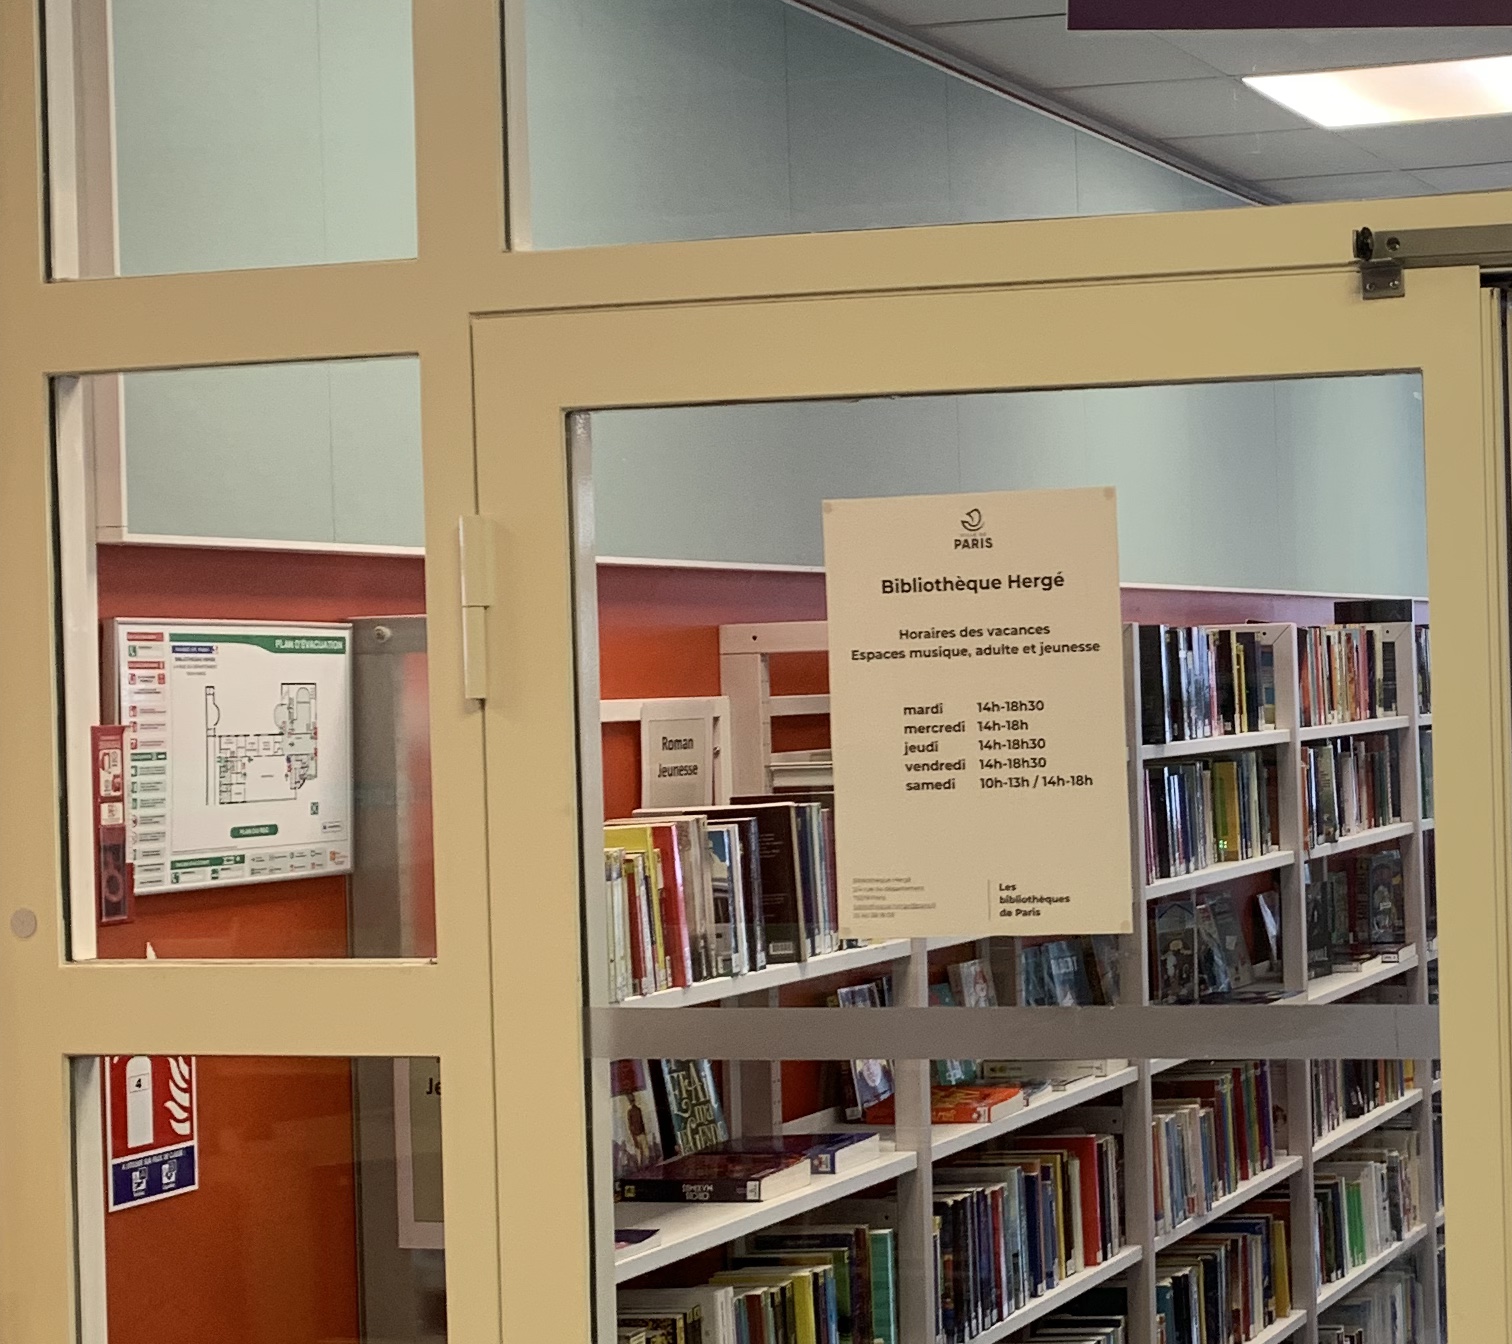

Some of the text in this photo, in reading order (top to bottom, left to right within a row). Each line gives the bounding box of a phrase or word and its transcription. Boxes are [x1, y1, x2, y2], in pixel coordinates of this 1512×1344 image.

[954, 537, 993, 549] PARIS
[881, 571, 1065, 594] Bibliothèque Hergé
[899, 624, 1051, 640] Horaires des vacances
[850, 641, 1101, 663] Espaces musique, adulte et jeunesse
[903, 699, 1045, 716] mardi 14h-18h30
[904, 719, 1029, 735] mercredi 14h-18h
[662, 736, 694, 751] Roman
[903, 737, 1046, 756] jeudi 14h-18h30
[657, 762, 698, 778] Jeunesse
[905, 756, 1047, 773] vendredi 14h-18h30
[906, 774, 1094, 791] samedi 10h-13h / 14h-18h
[999, 883, 1016, 892] Les
[999, 894, 1071, 906] bibliothèques
[999, 907, 1041, 917] de Paris
[135, 1078, 142, 1089] 4
